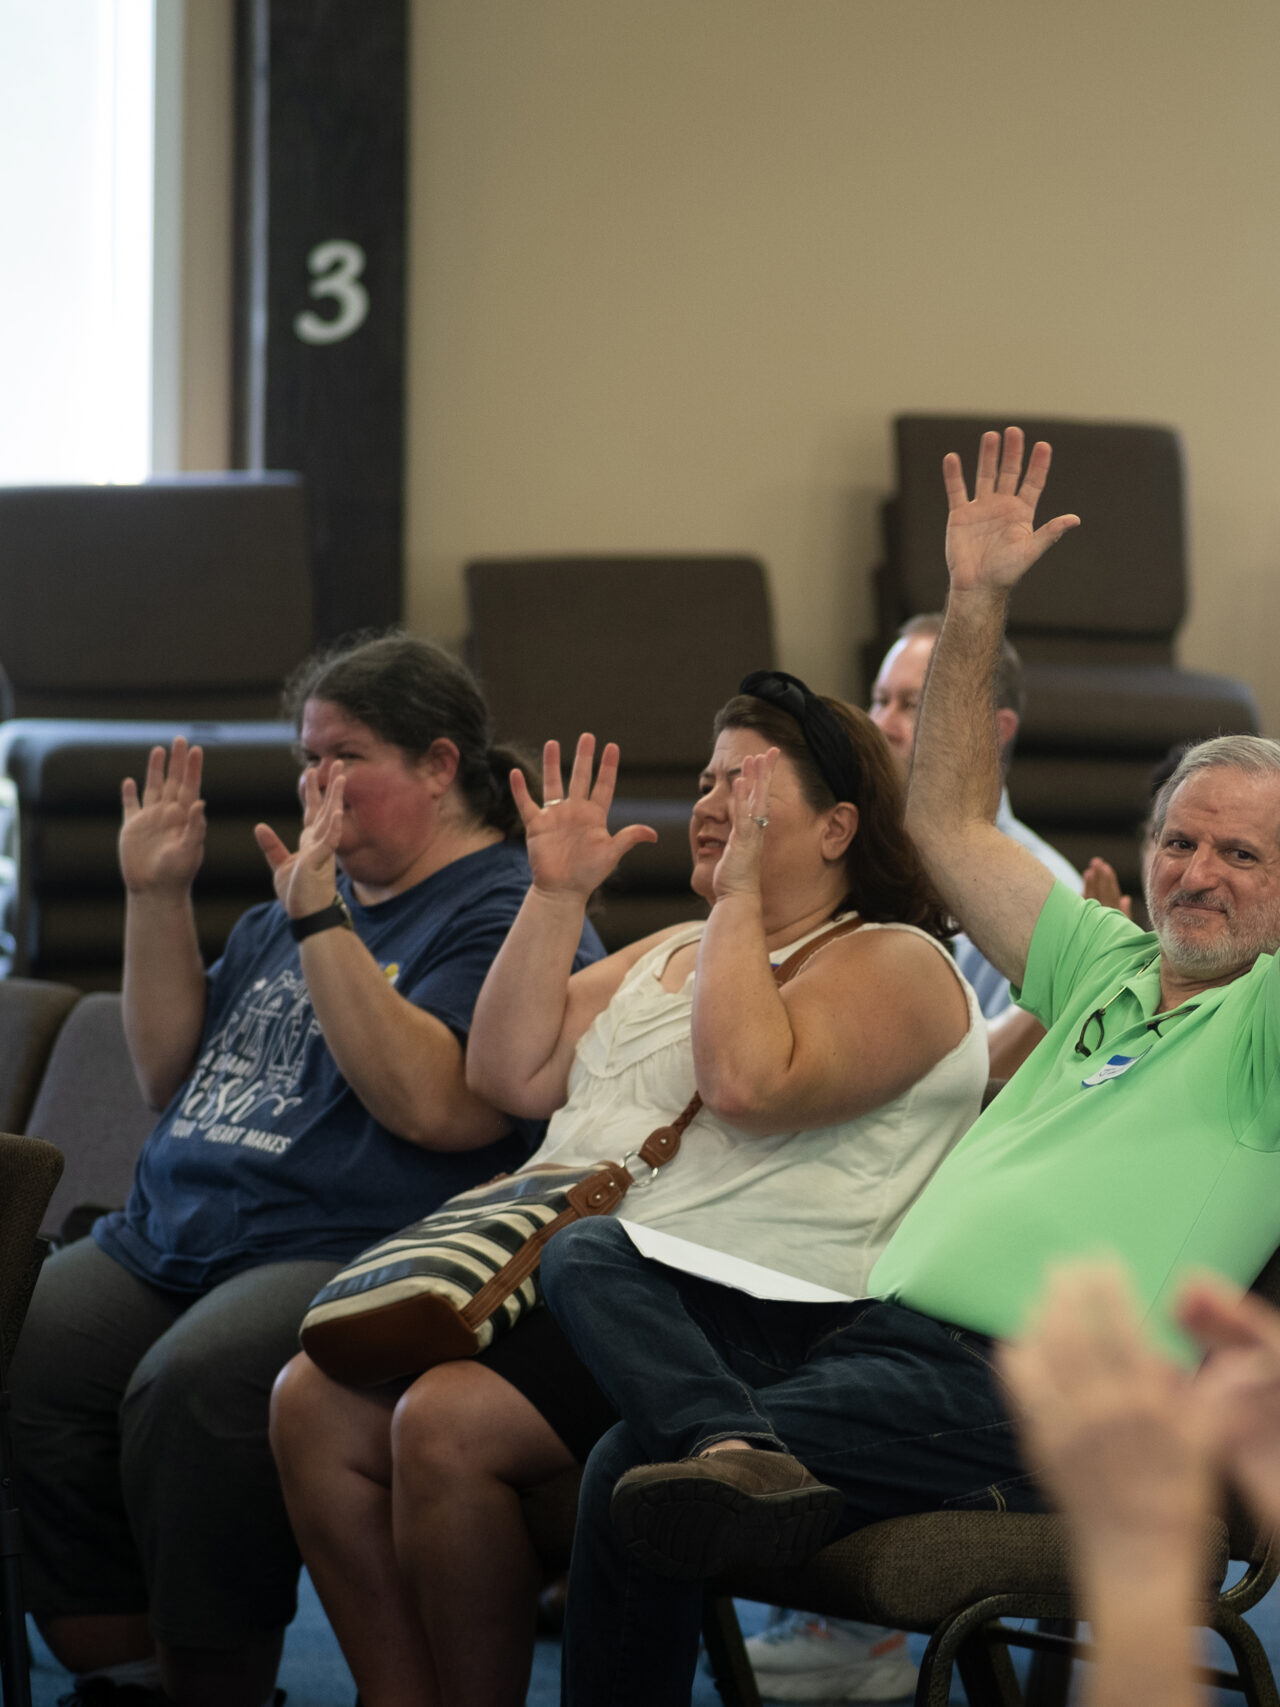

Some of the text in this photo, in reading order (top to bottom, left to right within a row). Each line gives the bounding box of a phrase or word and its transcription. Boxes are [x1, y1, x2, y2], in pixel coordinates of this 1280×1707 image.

[294, 240, 369, 345] 3
[204, 1123, 246, 1145] HEART
[241, 1128, 292, 1154] MAKES
